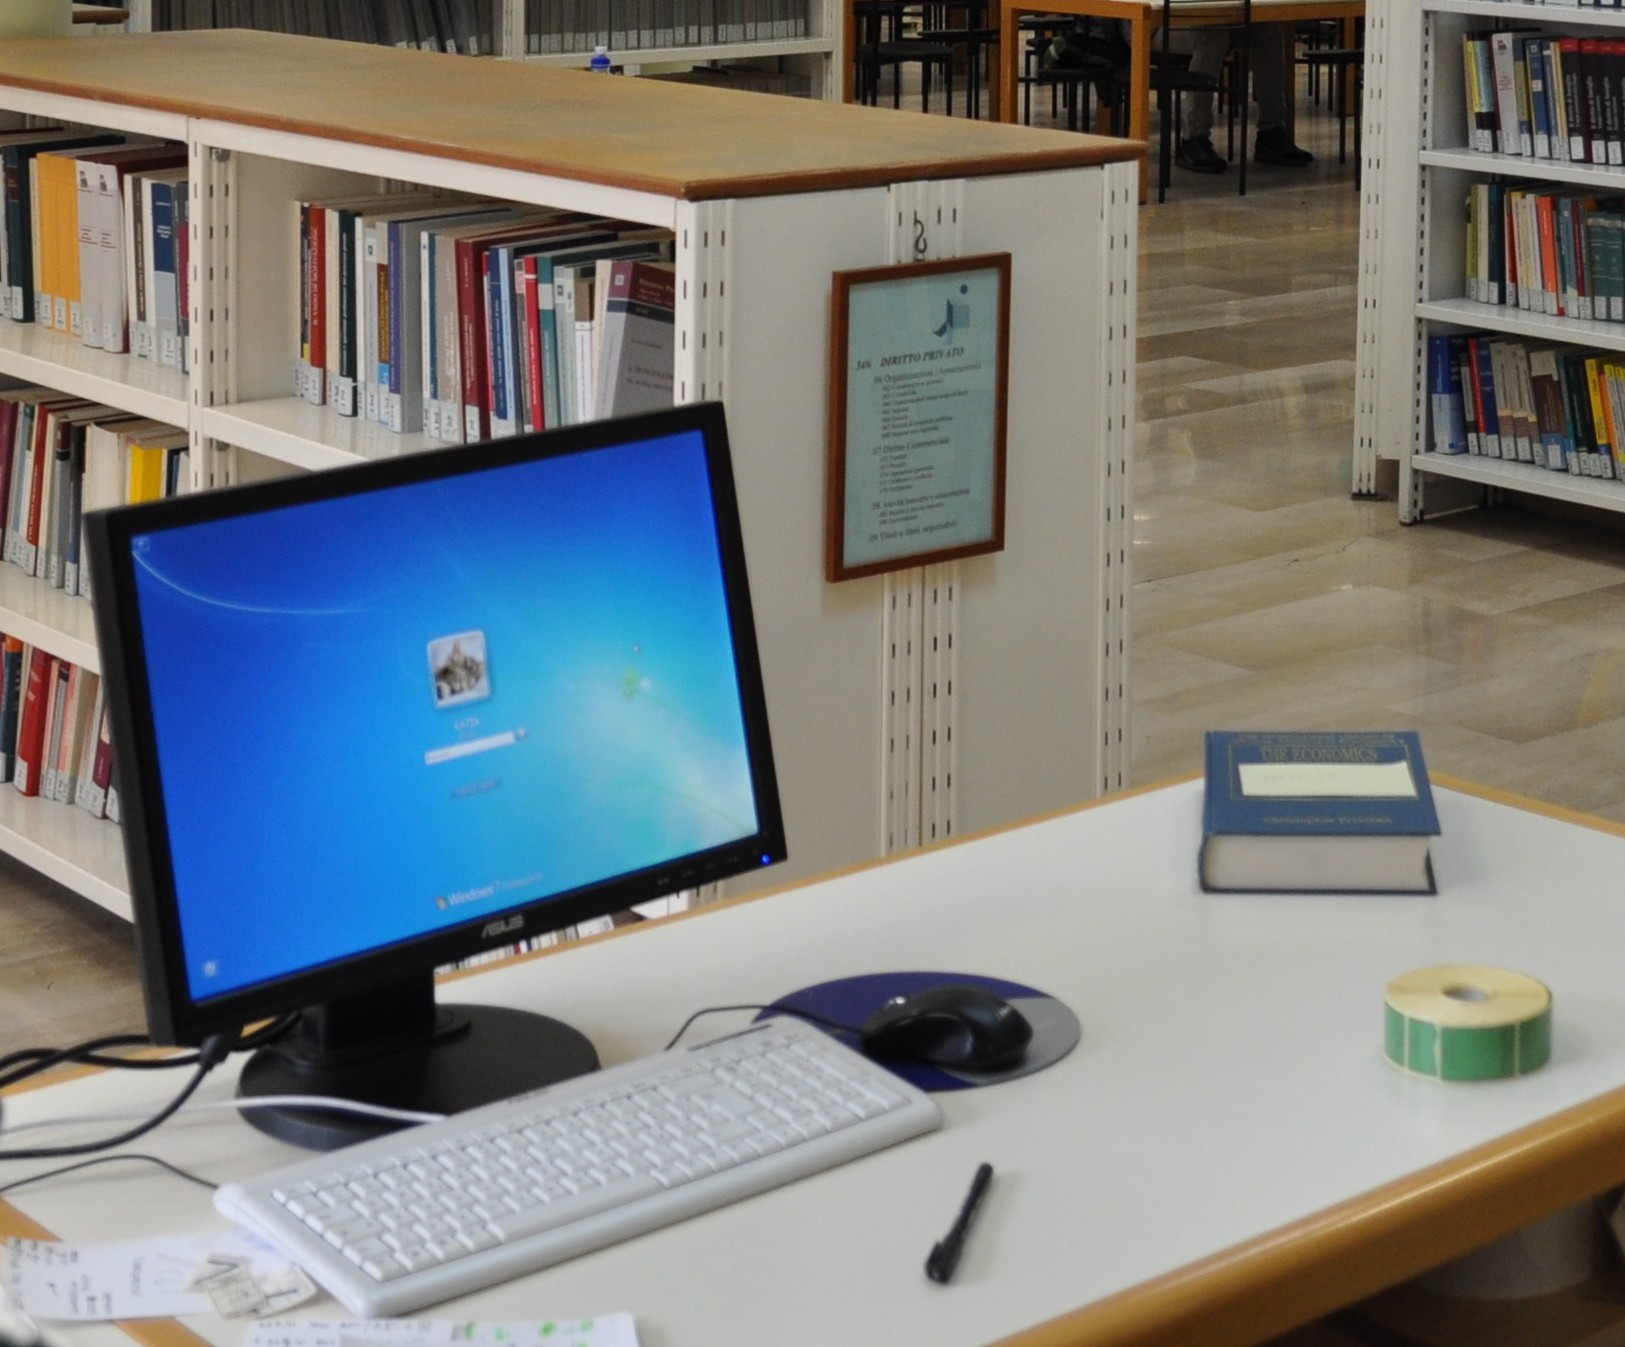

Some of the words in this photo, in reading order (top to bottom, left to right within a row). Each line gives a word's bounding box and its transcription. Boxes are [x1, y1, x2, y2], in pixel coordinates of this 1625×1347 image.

[856, 361, 871, 370] 346
[880, 353, 921, 367] DIRITTO
[923, 347, 964, 361] PRIVATO
[1292, 746, 1378, 761] ECONOMICS
[447, 883, 495, 907] Windows
[481, 914, 525, 939] ASUS
